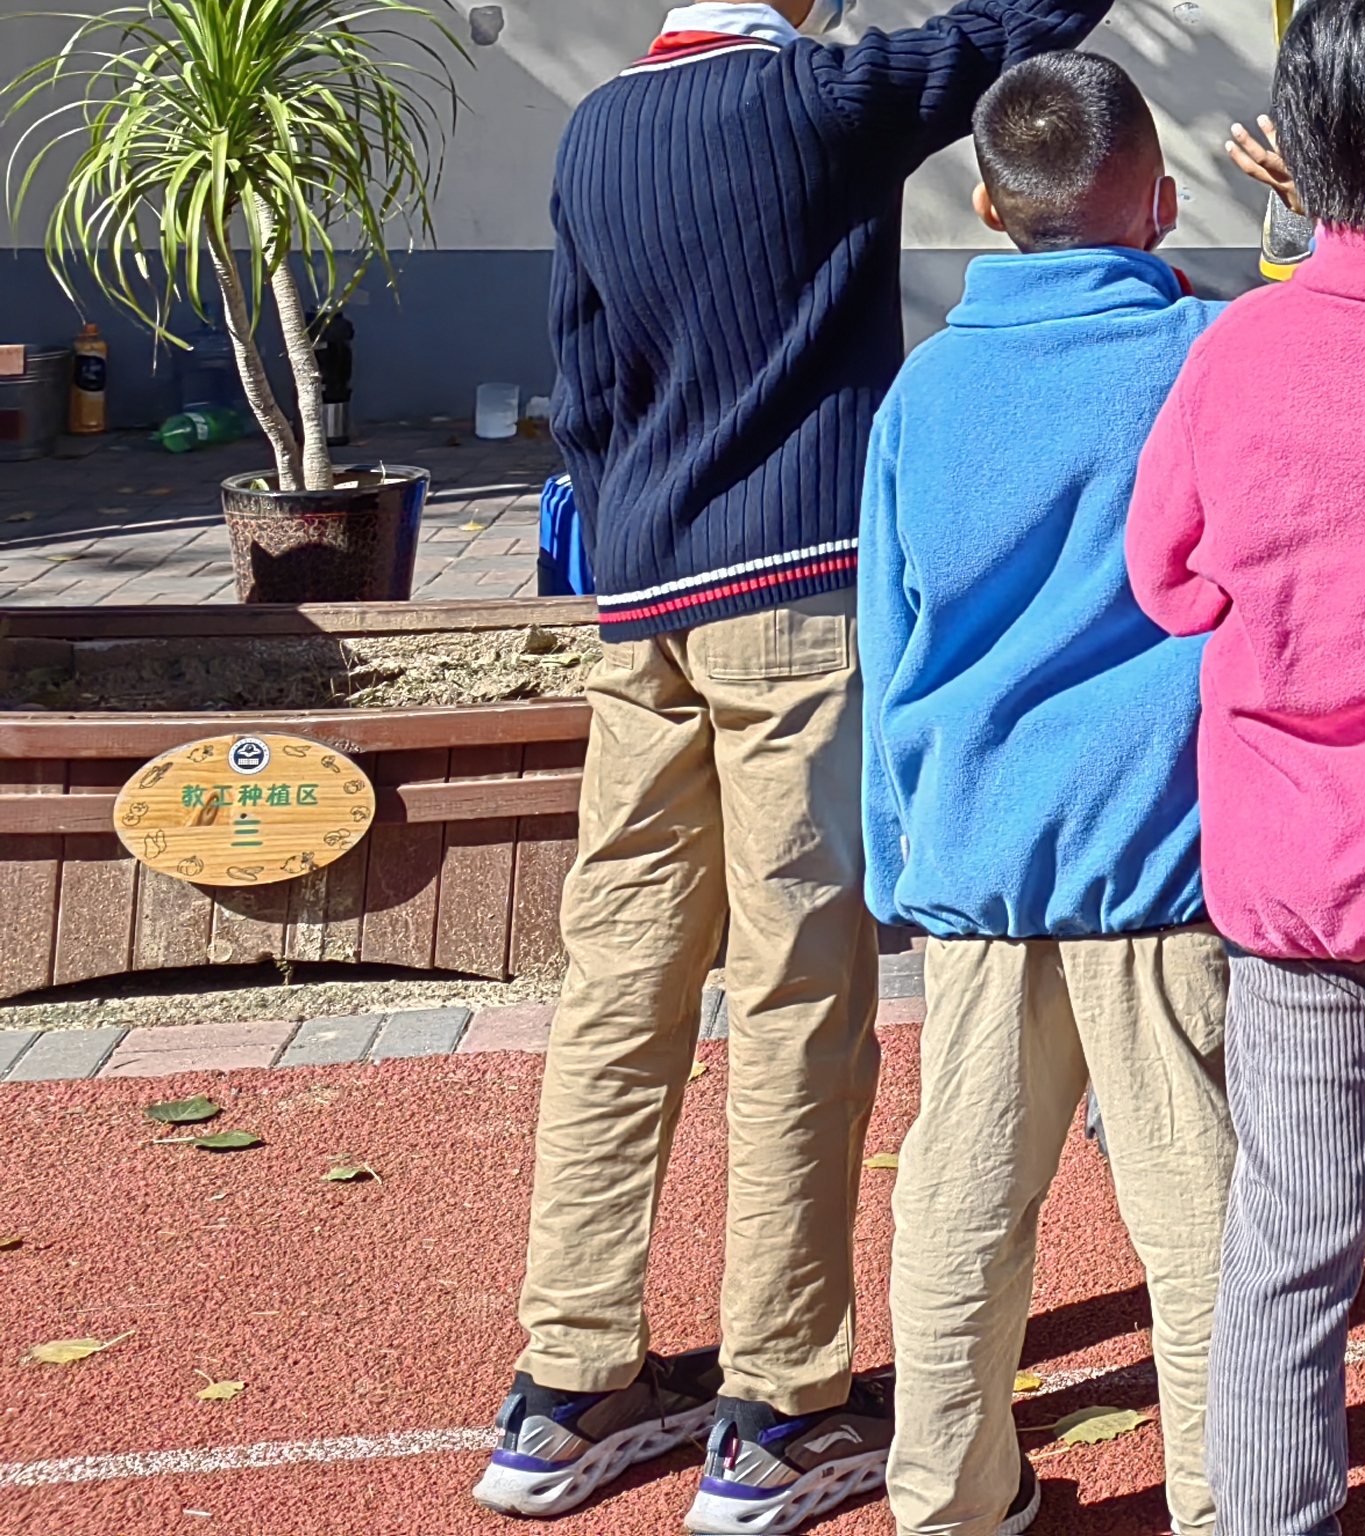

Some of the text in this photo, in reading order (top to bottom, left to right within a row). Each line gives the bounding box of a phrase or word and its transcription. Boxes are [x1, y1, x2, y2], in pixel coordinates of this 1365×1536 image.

[181, 783, 319, 808] 教工种植区
